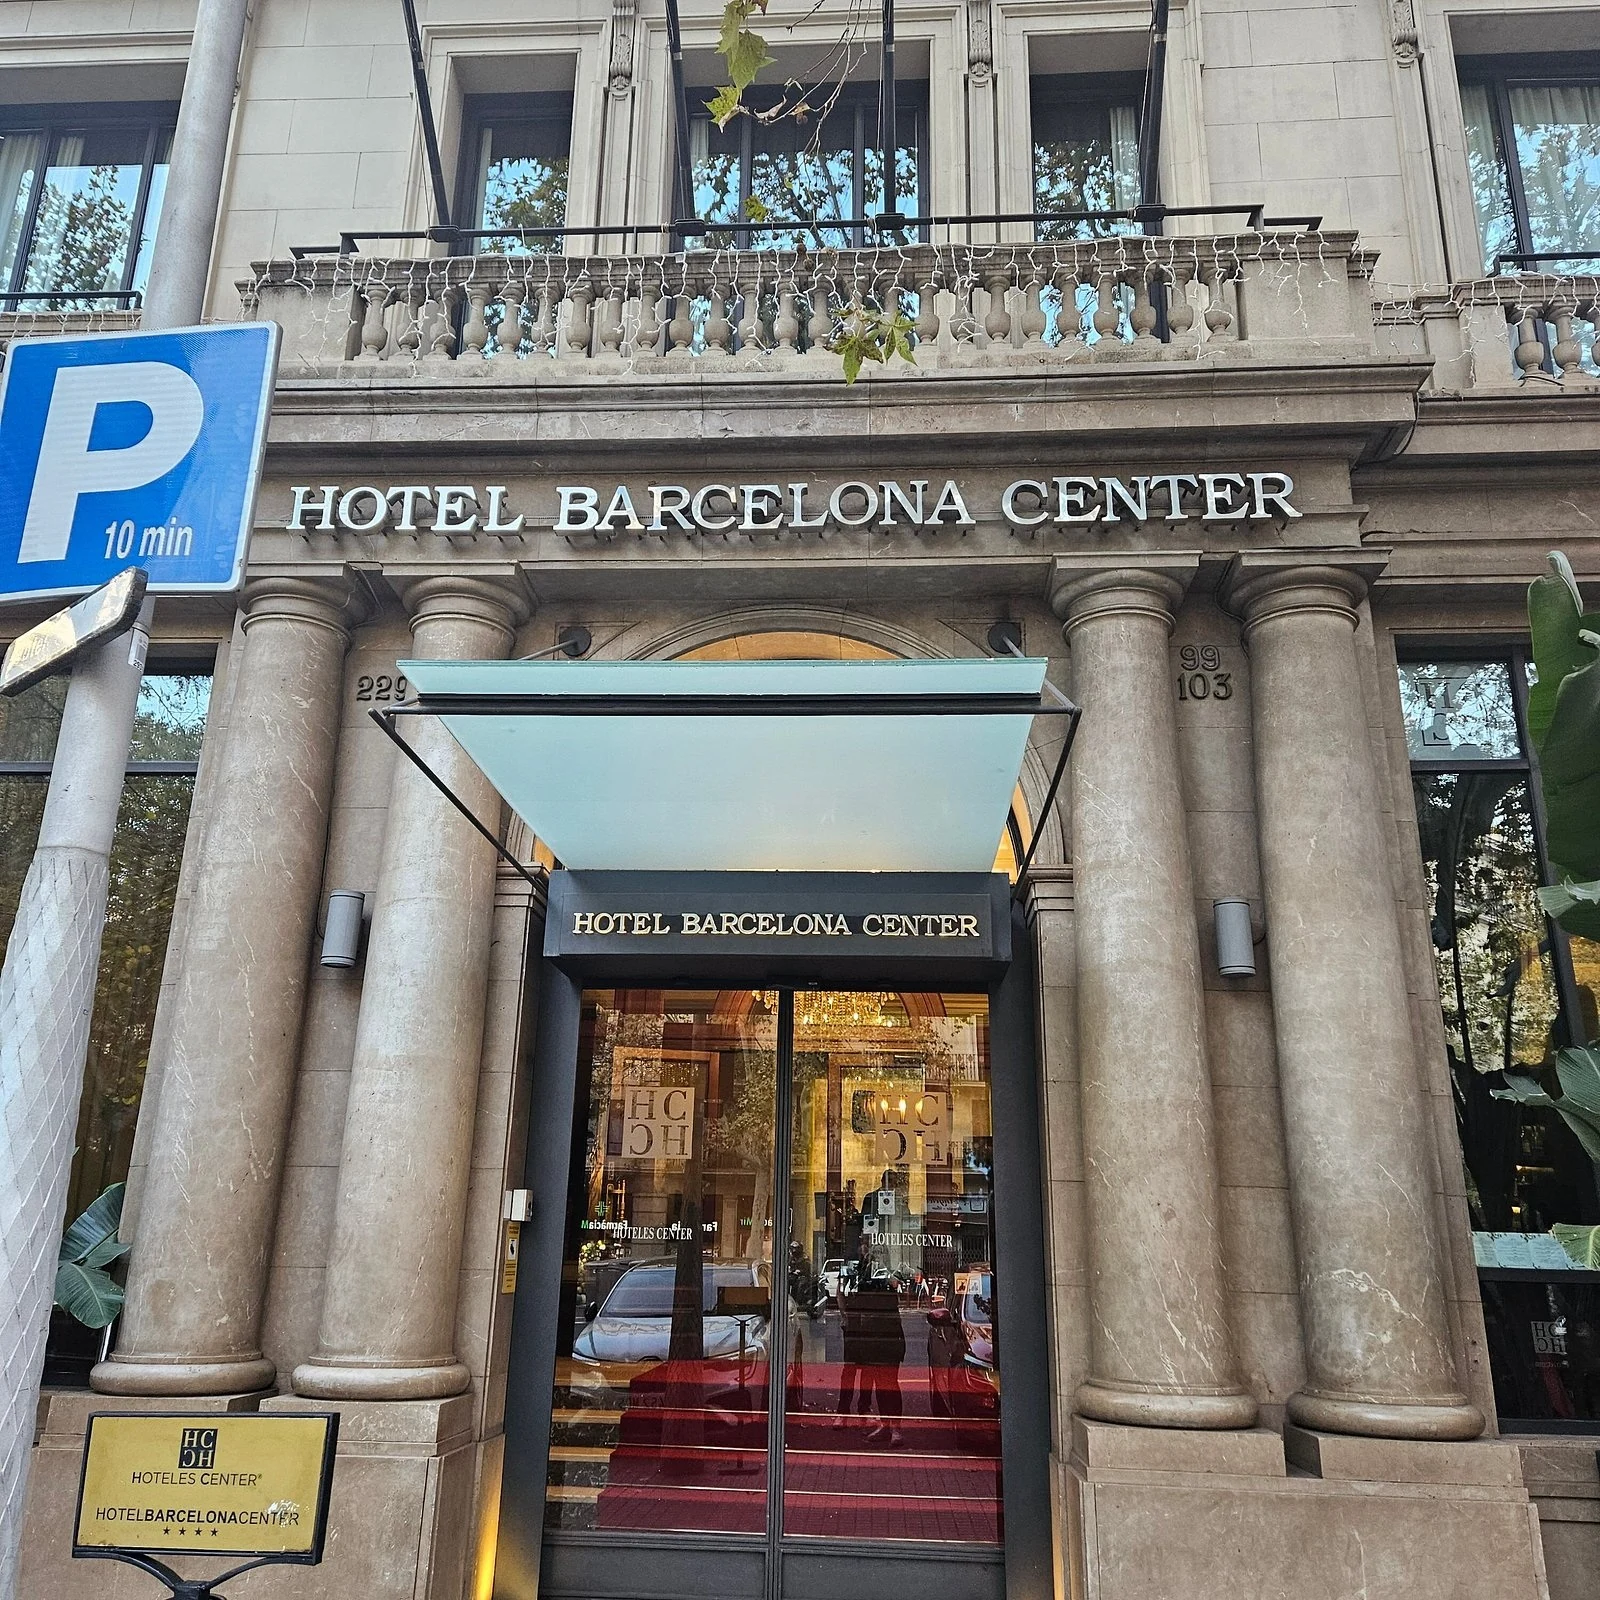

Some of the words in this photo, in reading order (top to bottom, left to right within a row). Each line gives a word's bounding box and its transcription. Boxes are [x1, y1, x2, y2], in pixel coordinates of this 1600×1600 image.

[17, 361, 204, 564] P
[285, 485, 526, 534] HOTEL
[552, 480, 976, 534] BARCELONA
[1001, 472, 1303, 530] CENTER
[104, 520, 135, 559] 10
[138, 515, 193, 557] min
[1180, 644, 1221, 672] 99
[356, 675, 408, 702] 229
[1177, 672, 1234, 700] 103
[572, 912, 670, 935] HOTEL
[681, 912, 852, 936] BARCELONA
[863, 913, 979, 938] CENTER
[871, 1232, 914, 1246] HOTELES
[915, 1233, 953, 1248] CENTER
[131, 1471, 196, 1485] HOTELES
